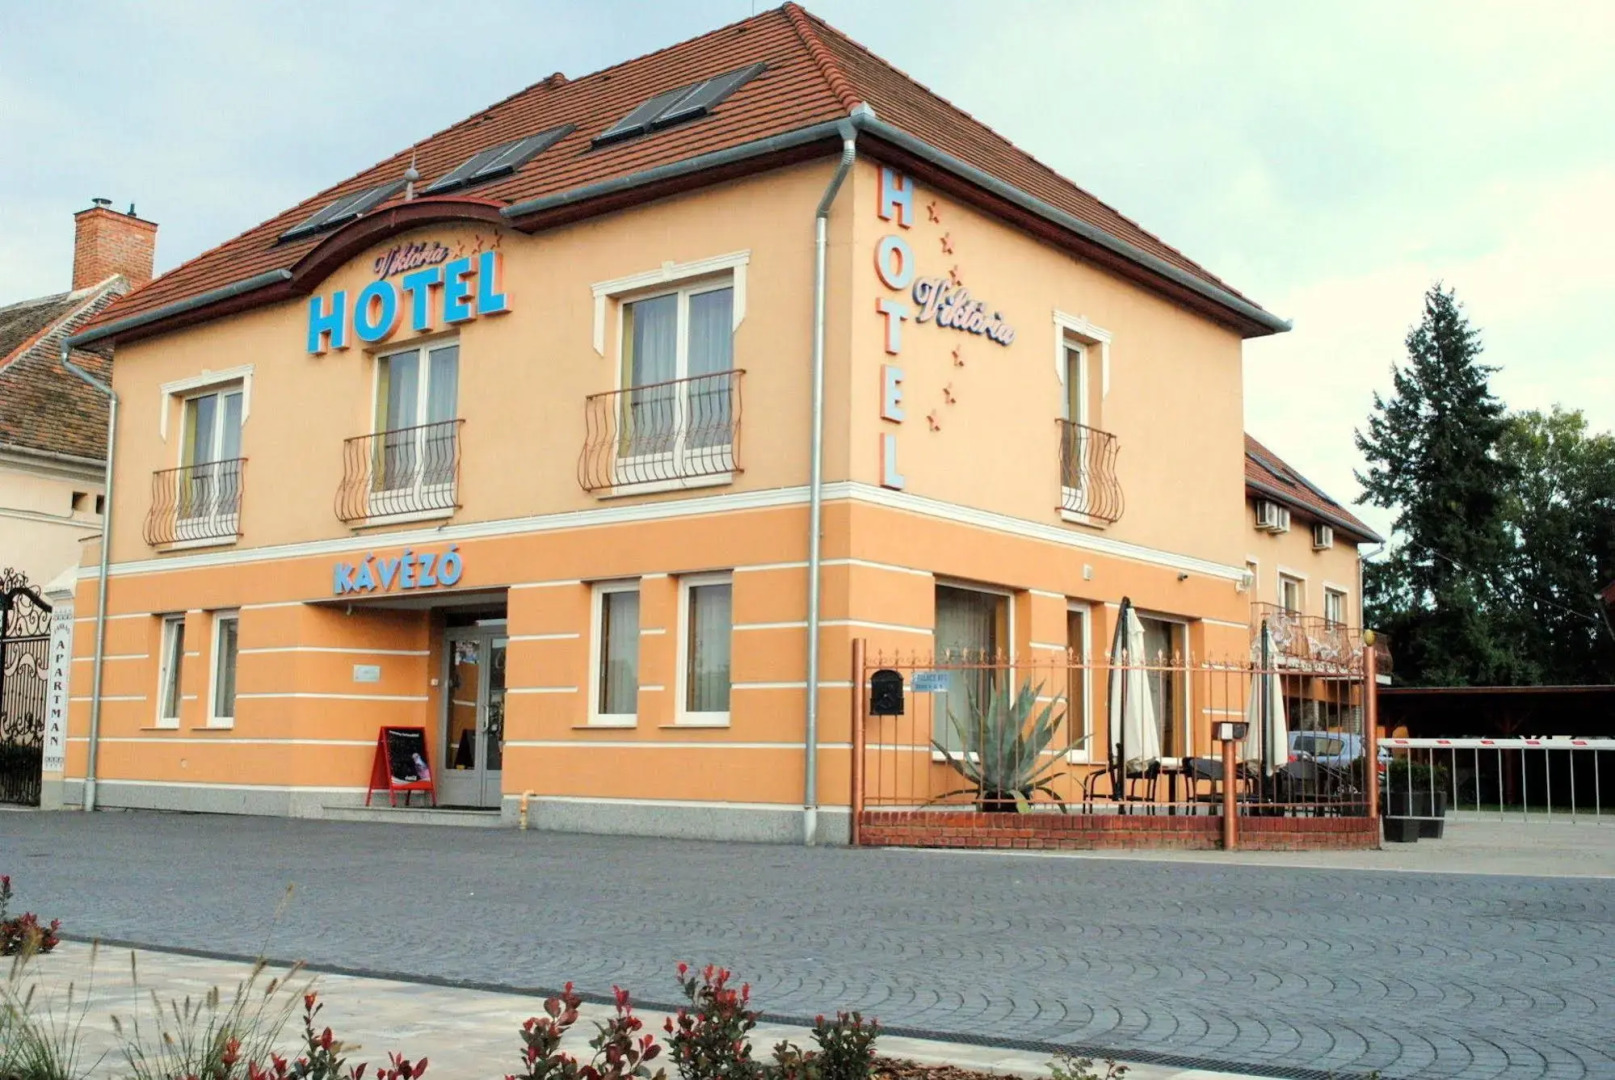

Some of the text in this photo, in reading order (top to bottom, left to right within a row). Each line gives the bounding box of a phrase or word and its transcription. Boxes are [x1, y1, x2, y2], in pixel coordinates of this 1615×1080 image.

[307, 251, 512, 355] HOTEL
[874, 165, 914, 491] HOTEL
[334, 543, 463, 595] KÁVÉZÓ
[50, 639, 66, 746] APARTMAN
